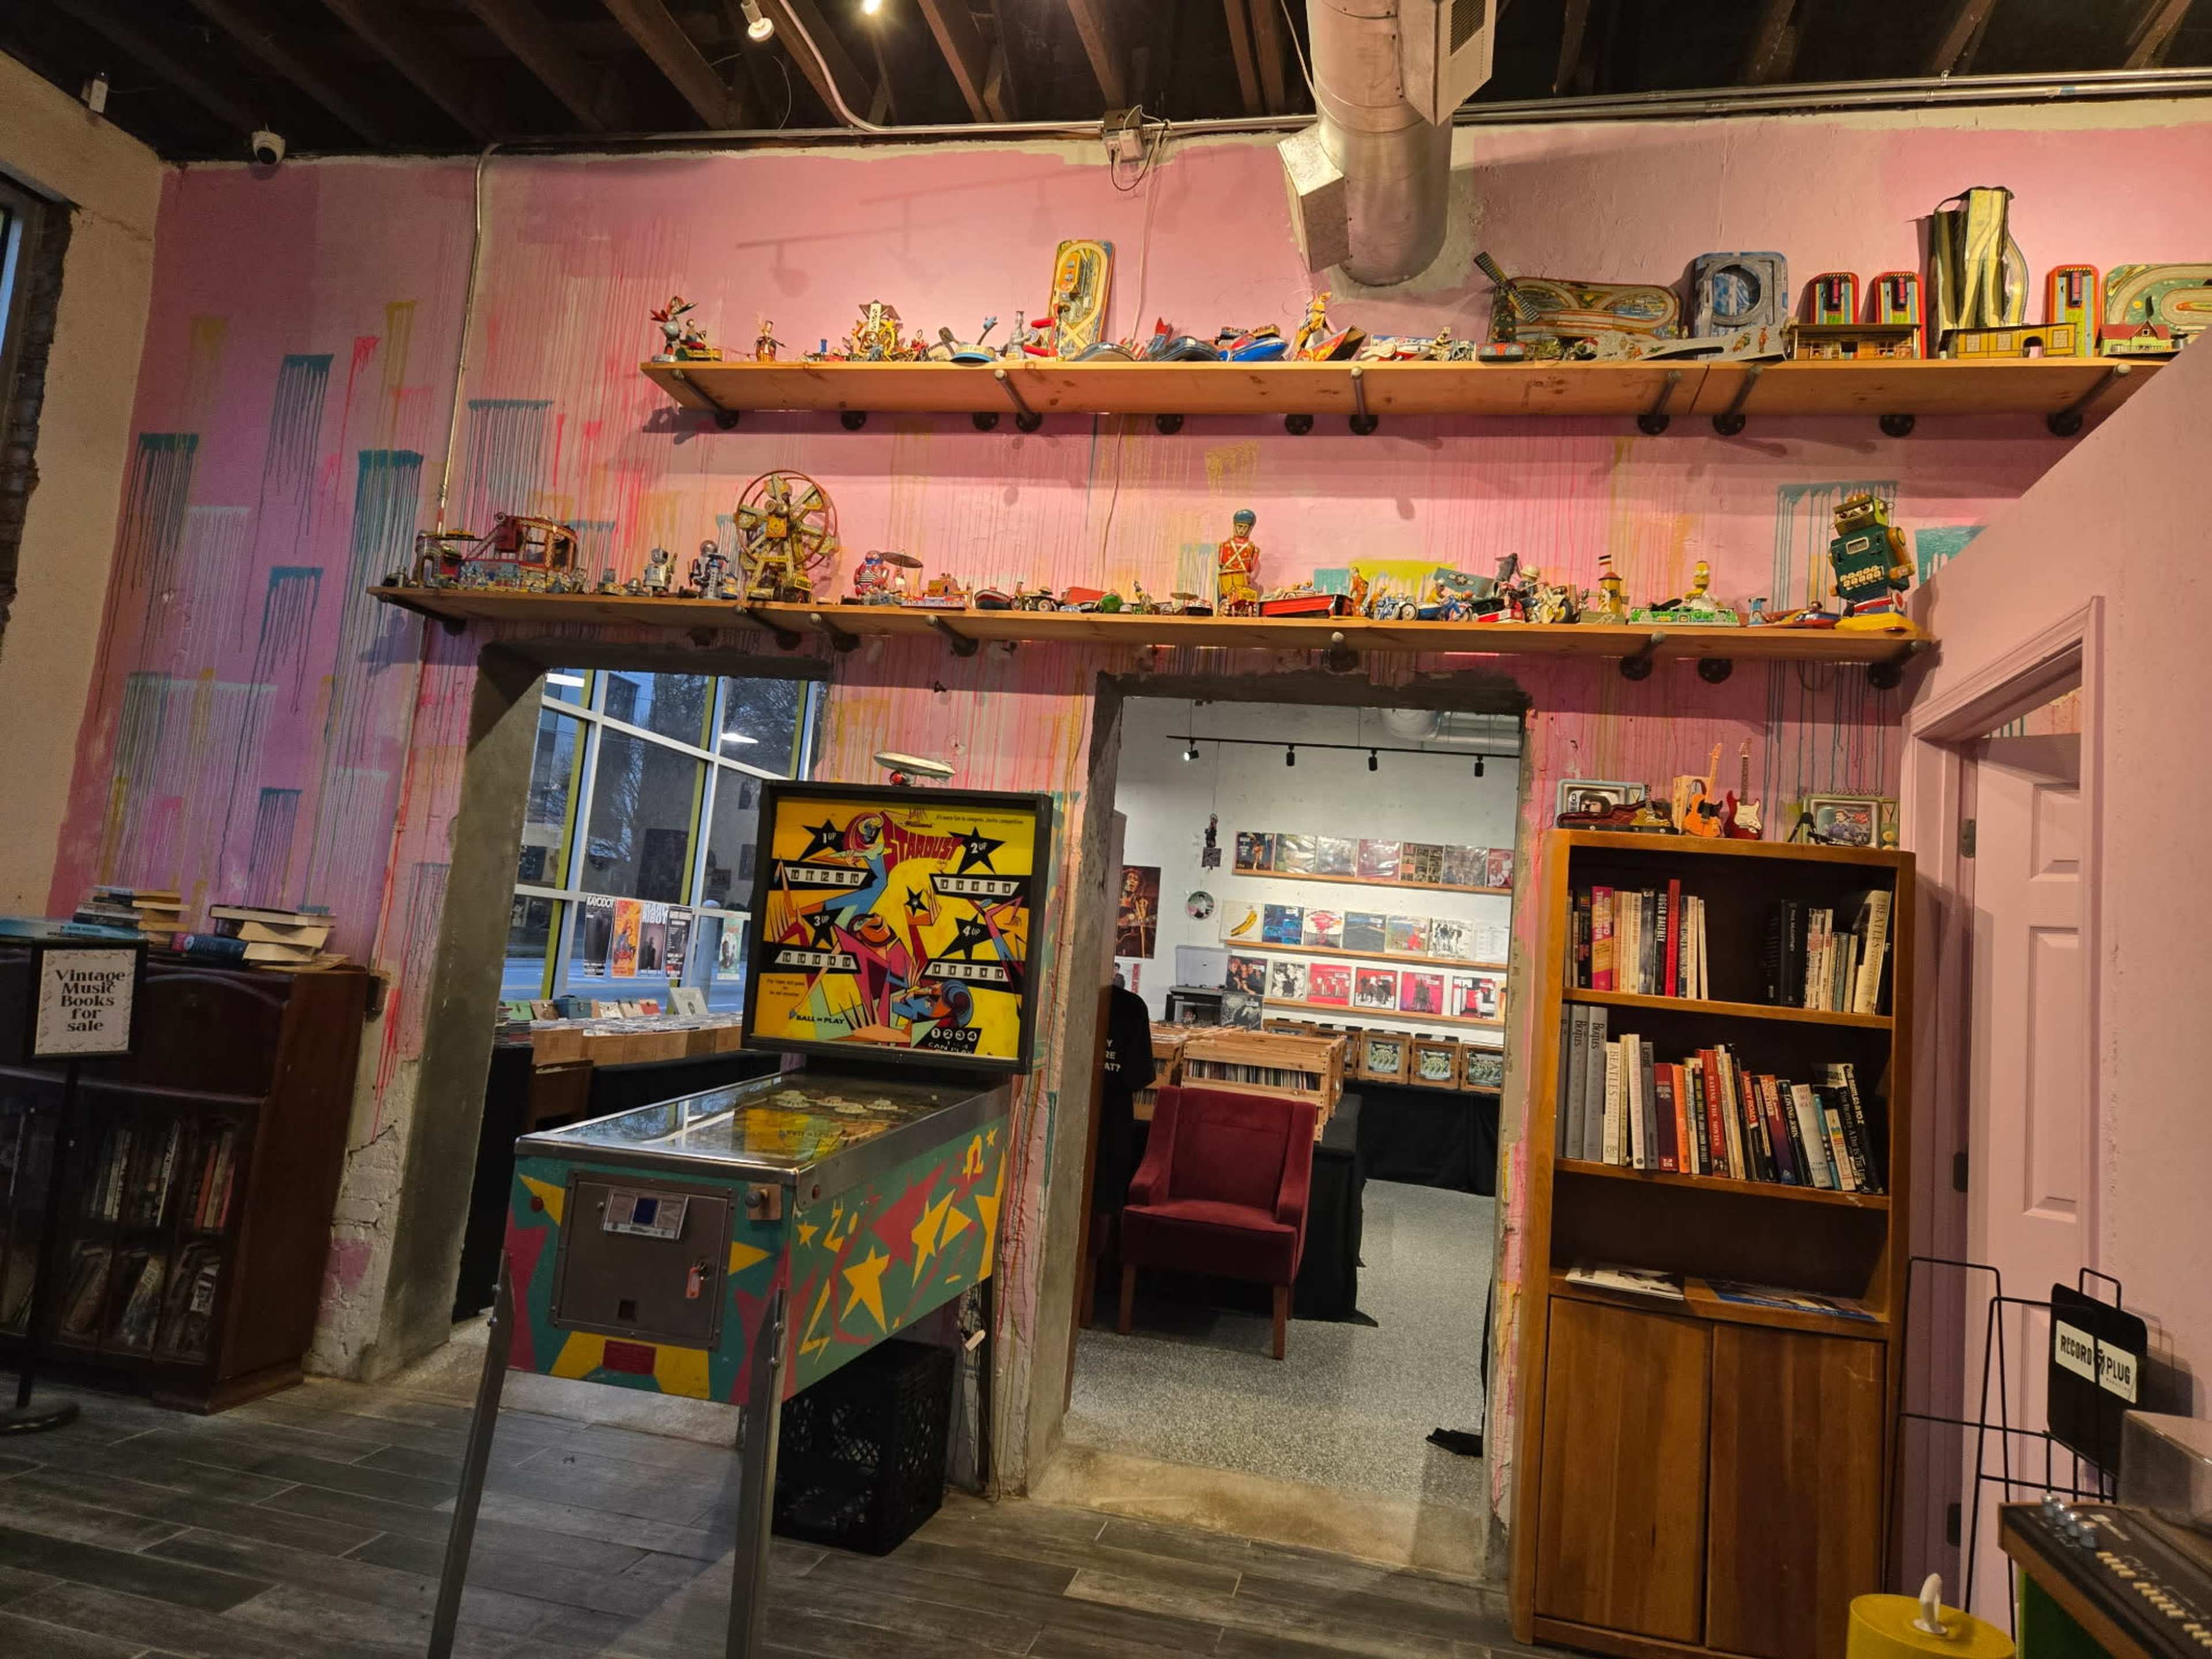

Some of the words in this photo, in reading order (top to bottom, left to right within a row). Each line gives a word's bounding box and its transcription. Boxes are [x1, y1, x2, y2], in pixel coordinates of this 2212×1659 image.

[823, 833, 827, 843] 1
[884, 831, 965, 864] STARDUST
[971, 843, 978, 854] 2
[979, 842, 988, 851] UP
[1658, 893, 1667, 914] ROGER
[814, 915, 820, 926] 3
[963, 926, 971, 936] 4
[1657, 916, 1666, 942] DALTREY
[1872, 903, 1887, 949] BEATLES
[56, 969, 126, 986] Vintage
[62, 982, 115, 994] Music
[61, 995, 115, 1007] Books
[72, 1008, 102, 1020] for
[67, 1021, 103, 1032] sale
[1573, 1020, 1587, 1047] BEATLES
[1590, 1022, 1605, 1050] BEATLES
[928, 1042, 948, 1051] CAN
[1104, 1062, 1121, 1072] AT?
[1608, 1050, 1620, 1096] BEATLES
[1744, 1076, 1753, 1099] ABBEY
[1763, 1078, 1775, 1116] TOGETHER
[1747, 1100, 1756, 1121] ROAD
[1784, 1094, 1794, 1119] LOVING
[1789, 1120, 1799, 1138] JOHN
[1712, 1121, 1720, 1147] MOVIES
[2061, 1335, 2092, 1366] RECORD
[2107, 1356, 2131, 1385] PLUG
